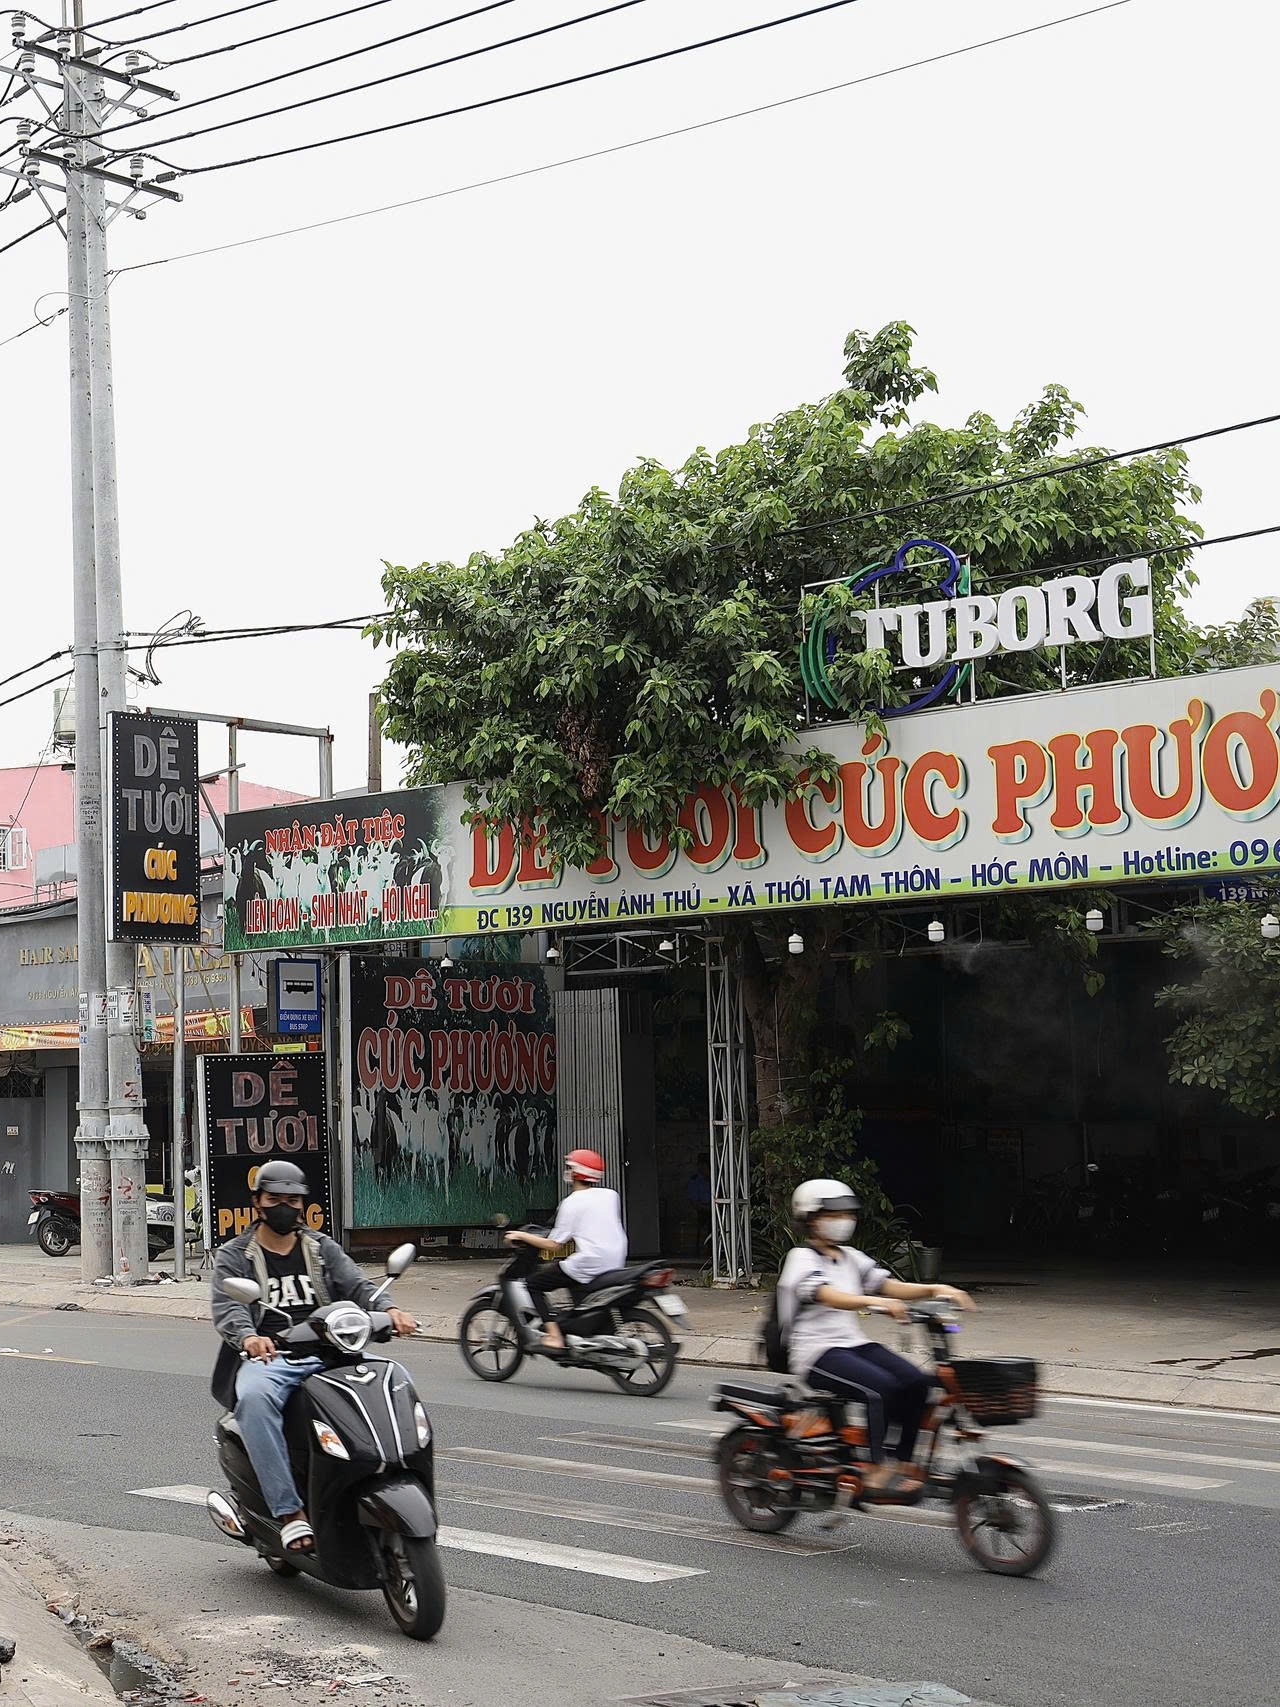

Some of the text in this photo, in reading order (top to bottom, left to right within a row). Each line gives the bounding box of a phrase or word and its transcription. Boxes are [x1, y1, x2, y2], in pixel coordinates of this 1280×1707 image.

[851, 557, 1153, 668] TUBORG
[133, 726, 180, 780] DÊ
[121, 782, 193, 836] TƯƠI
[784, 732, 964, 858] CÚC
[264, 807, 406, 857] NHẬN ĐẶT TIỆC
[144, 842, 178, 881] CÚC
[245, 891, 268, 934] LIÊN
[269, 896, 300, 932] HOAN
[311, 892, 336, 928] SINH
[338, 884, 369, 934] NHẬT
[381, 880, 401, 929] HỘI
[477, 909, 499, 930] ĐC
[505, 904, 533, 928] 139
[541, 890, 610, 924] NGUYỄN
[616, 888, 655, 917] ẢNH
[662, 882, 701, 914] THỦ
[727, 880, 757, 908] XÃ
[764, 873, 811, 904] THỚI
[819, 873, 872, 900] TAM
[880, 864, 941, 896] THÔN
[971, 856, 1018, 888] HÓC
[1028, 850, 1089, 883] MÔN
[1123, 846, 1218, 876] Hotline:
[1219, 887, 1248, 901] 139
[383, 967, 536, 1014] DÊ TƯƠI
[357, 1009, 557, 1096] CÚC PHƯƠNG
[232, 1060, 299, 1108] DÊ
[216, 1109, 319, 1155] TƯƠI
[218, 1203, 325, 1236] PHG
